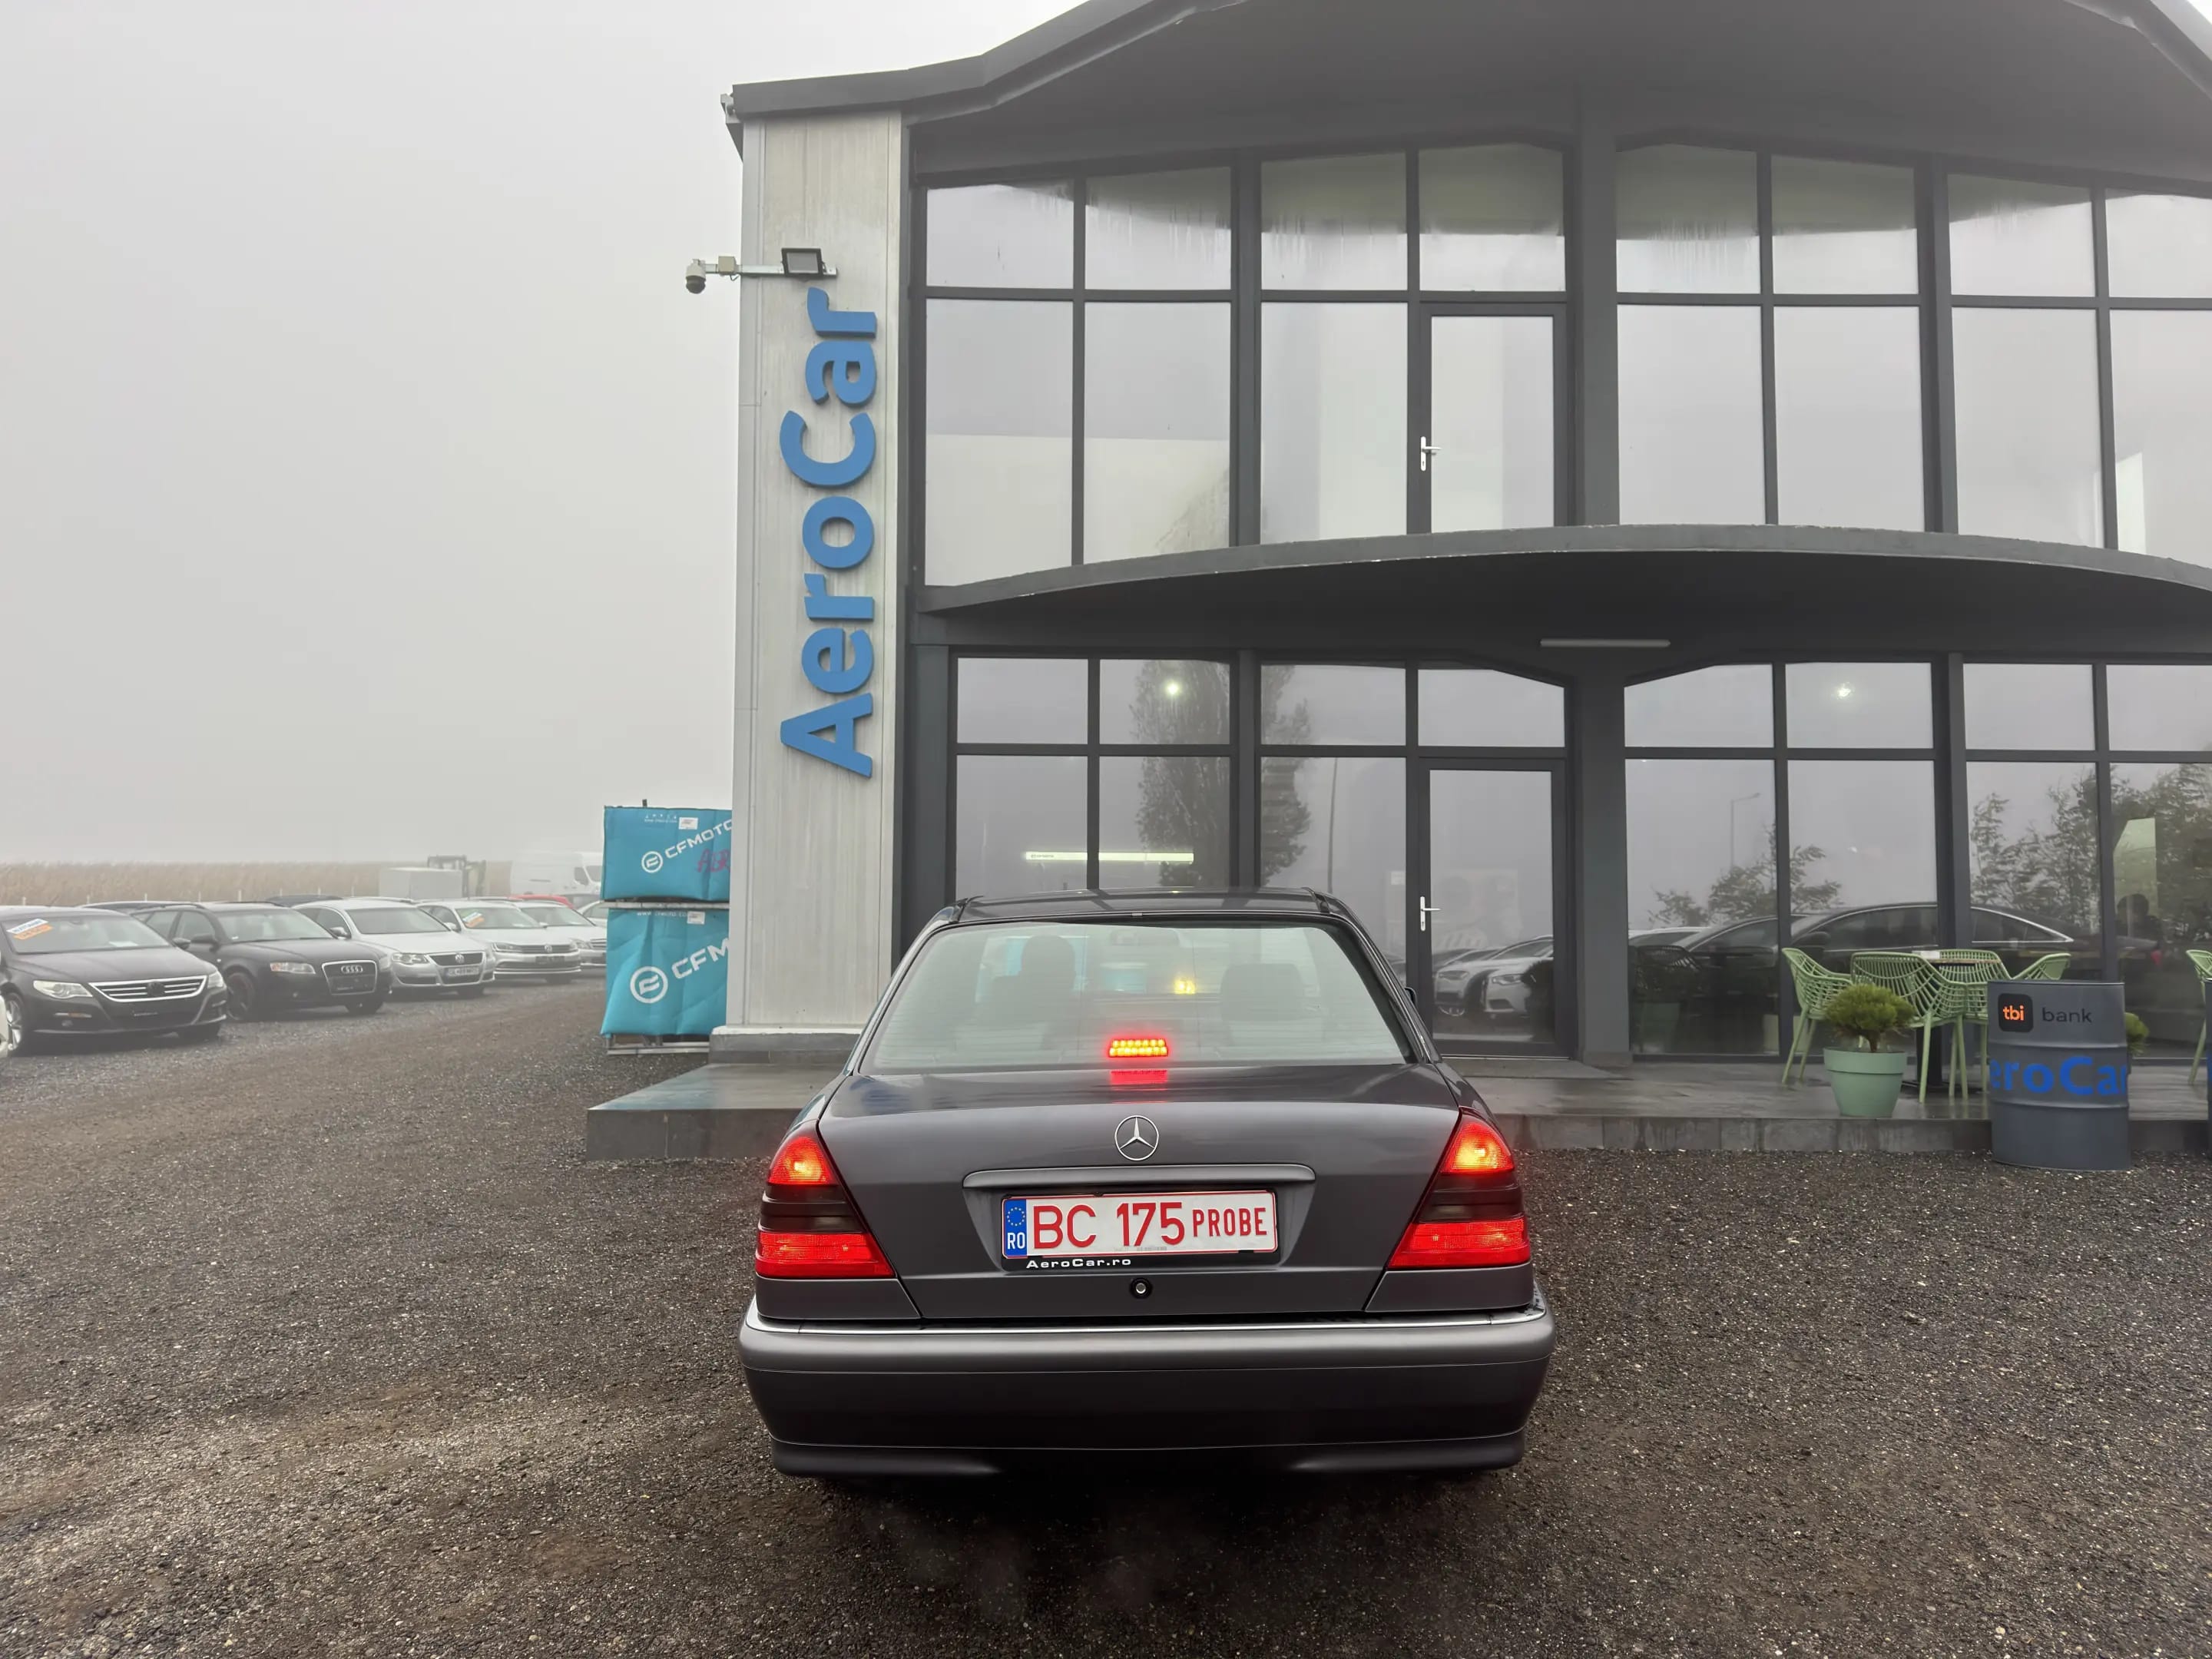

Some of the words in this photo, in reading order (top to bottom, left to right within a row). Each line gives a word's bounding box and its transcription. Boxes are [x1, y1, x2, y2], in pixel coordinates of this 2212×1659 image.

[780, 286, 877, 778] AeroCar
[2002, 1005, 2025, 1021] tbi
[2041, 1007, 2092, 1024] bank
[1034, 1204, 1097, 1249] BC
[1116, 1201, 1185, 1247] 175
[1192, 1207, 1267, 1237] PROBE
[1007, 1232, 1025, 1250] RO
[1025, 1258, 1131, 1269] AeroCar.ro
